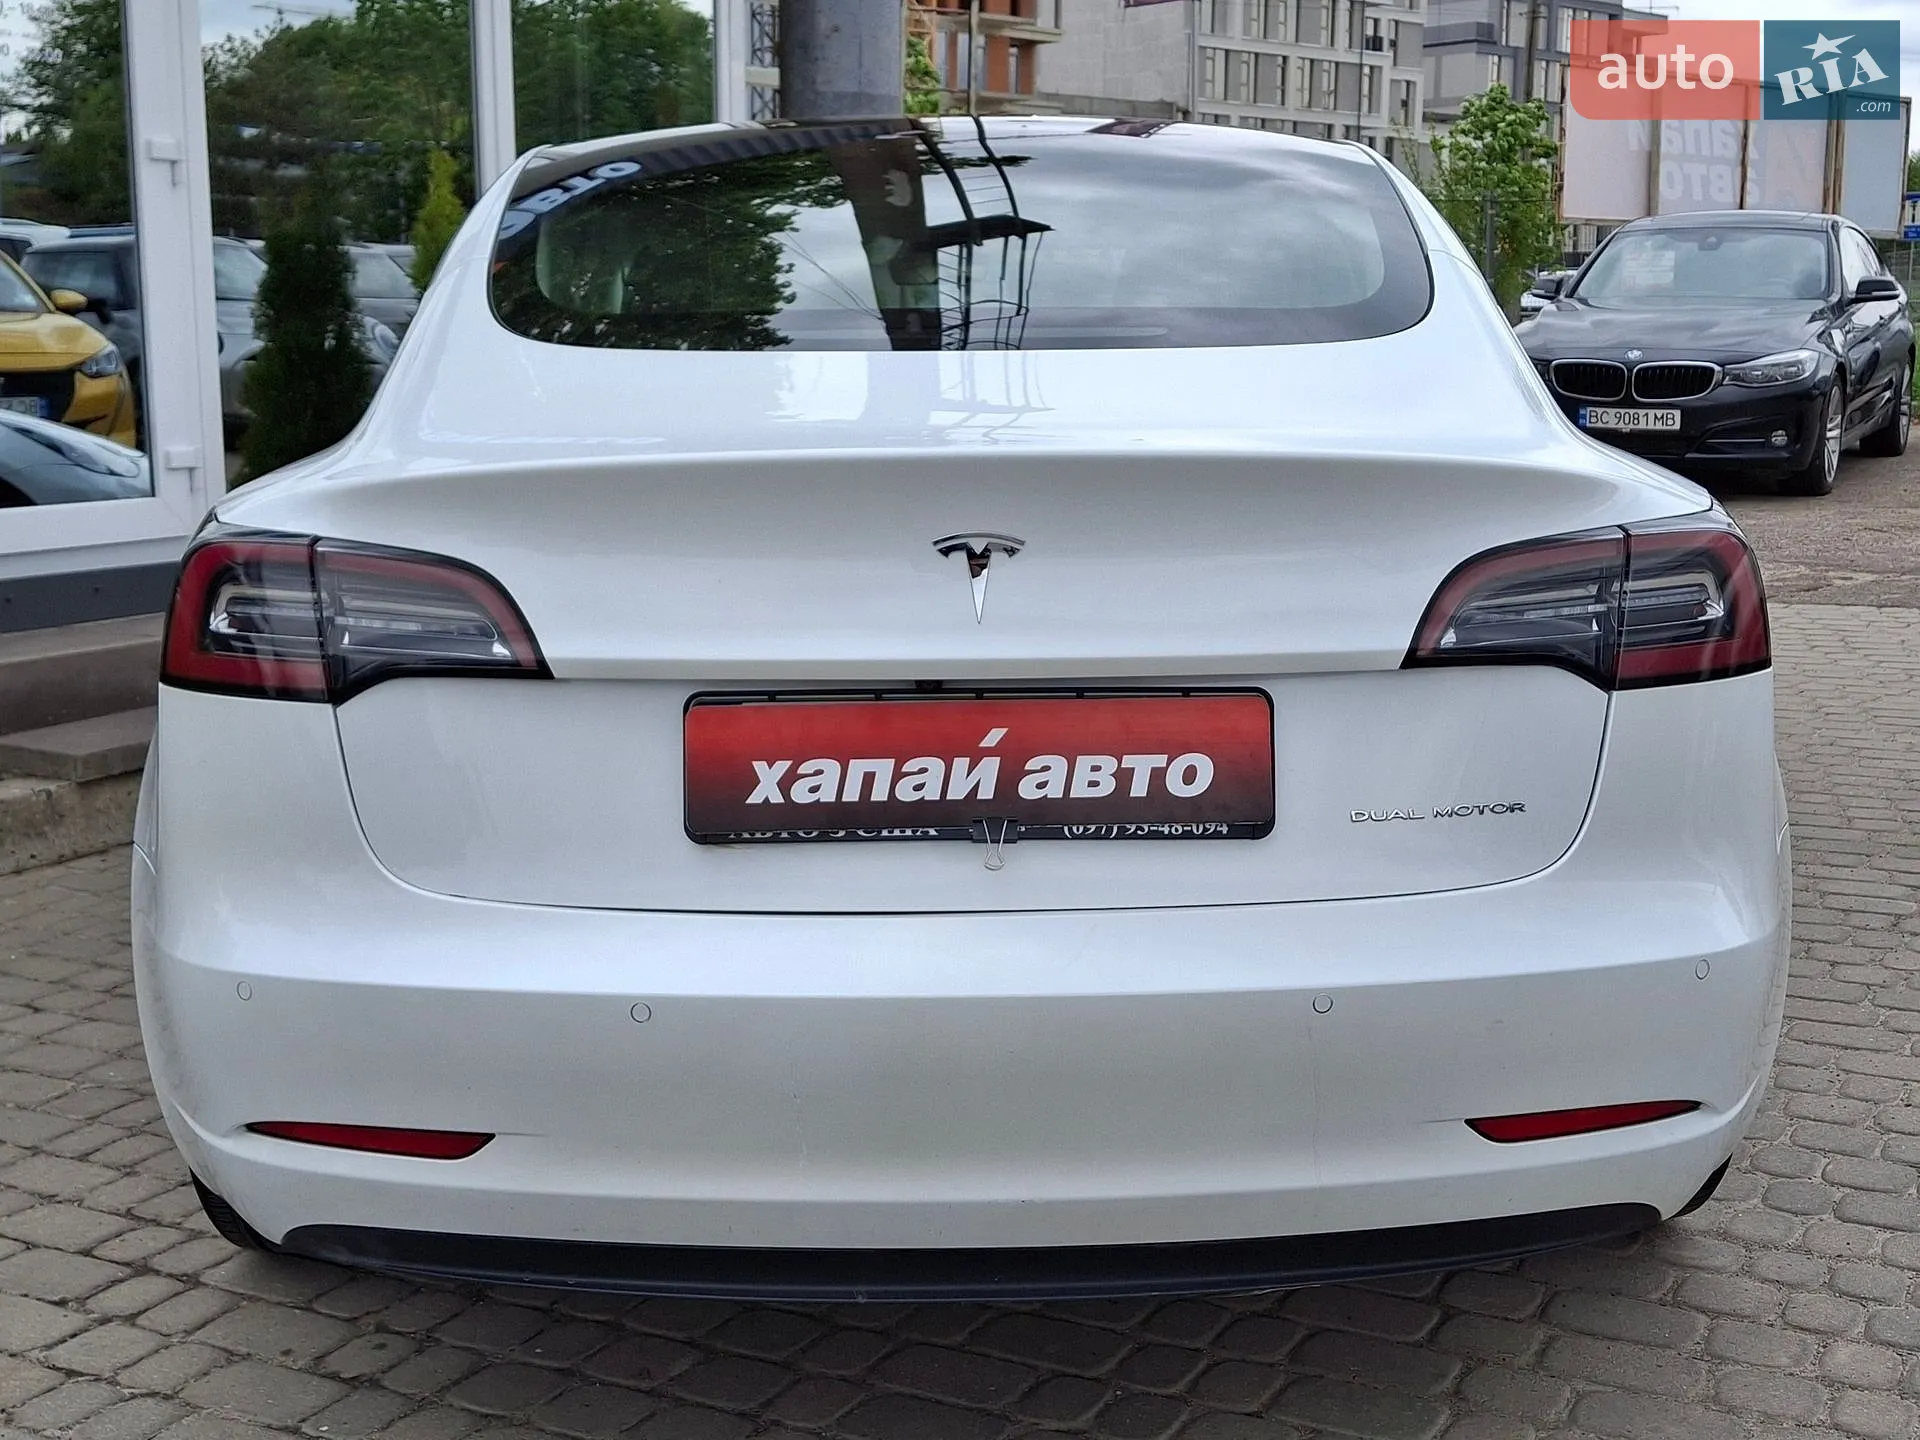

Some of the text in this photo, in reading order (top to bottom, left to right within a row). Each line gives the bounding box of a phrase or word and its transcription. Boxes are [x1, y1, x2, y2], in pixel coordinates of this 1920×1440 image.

[1588, 410, 1676, 427] BC 9081 MB
[1017, 752, 1215, 800] авто
[1350, 801, 1528, 823] DUAL MOTOR
